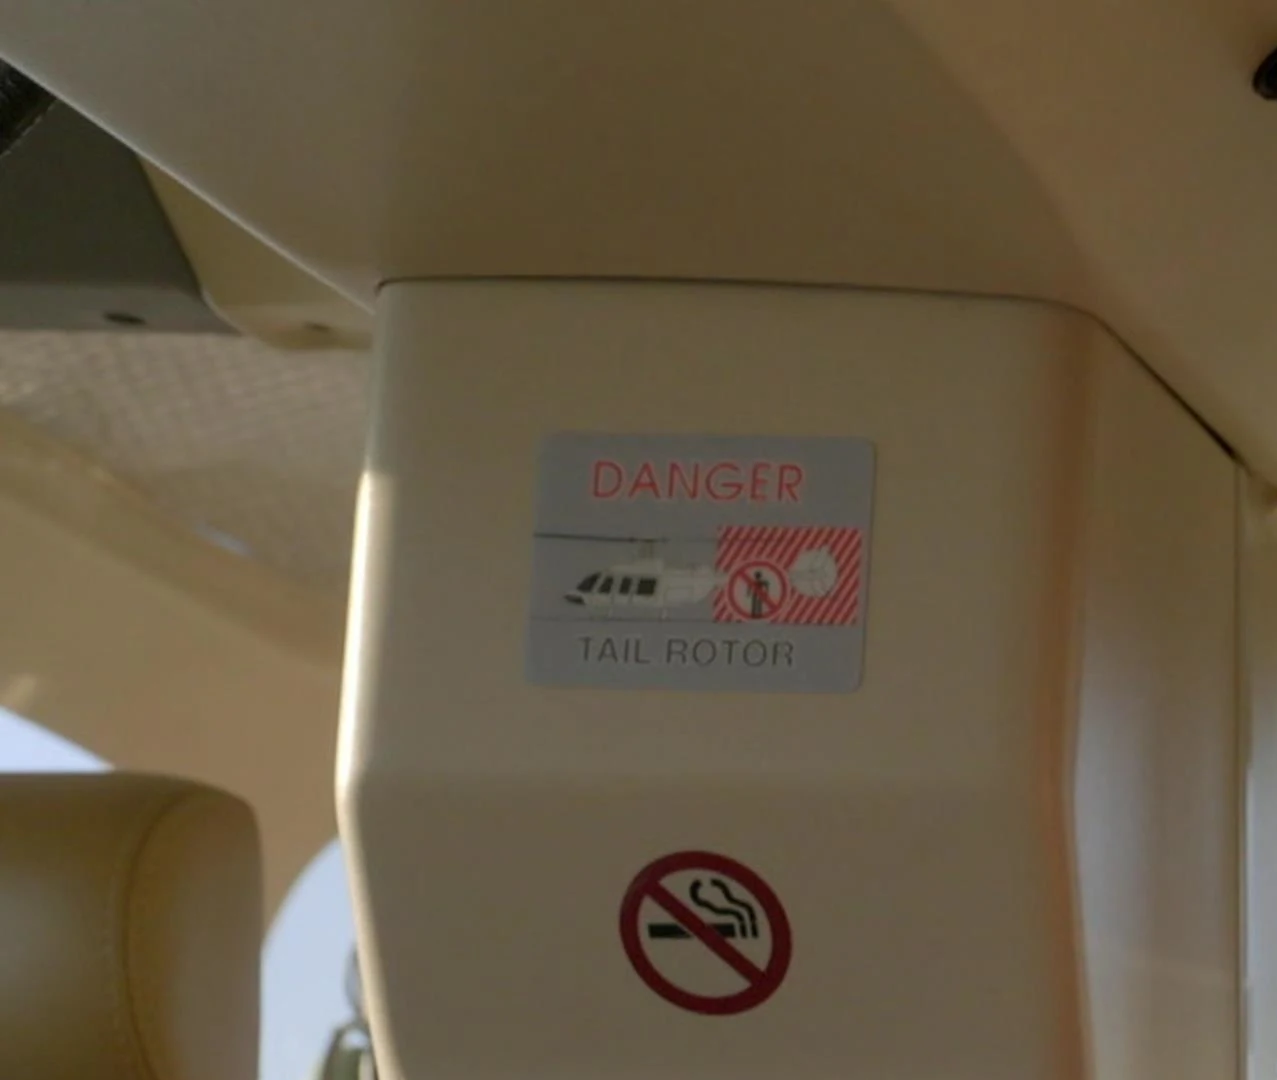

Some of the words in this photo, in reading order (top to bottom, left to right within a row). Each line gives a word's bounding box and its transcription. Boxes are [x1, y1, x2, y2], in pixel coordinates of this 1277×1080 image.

[592, 461, 804, 502] DANGER
[579, 636, 651, 664] TAIL
[665, 638, 794, 667] ROTOR
